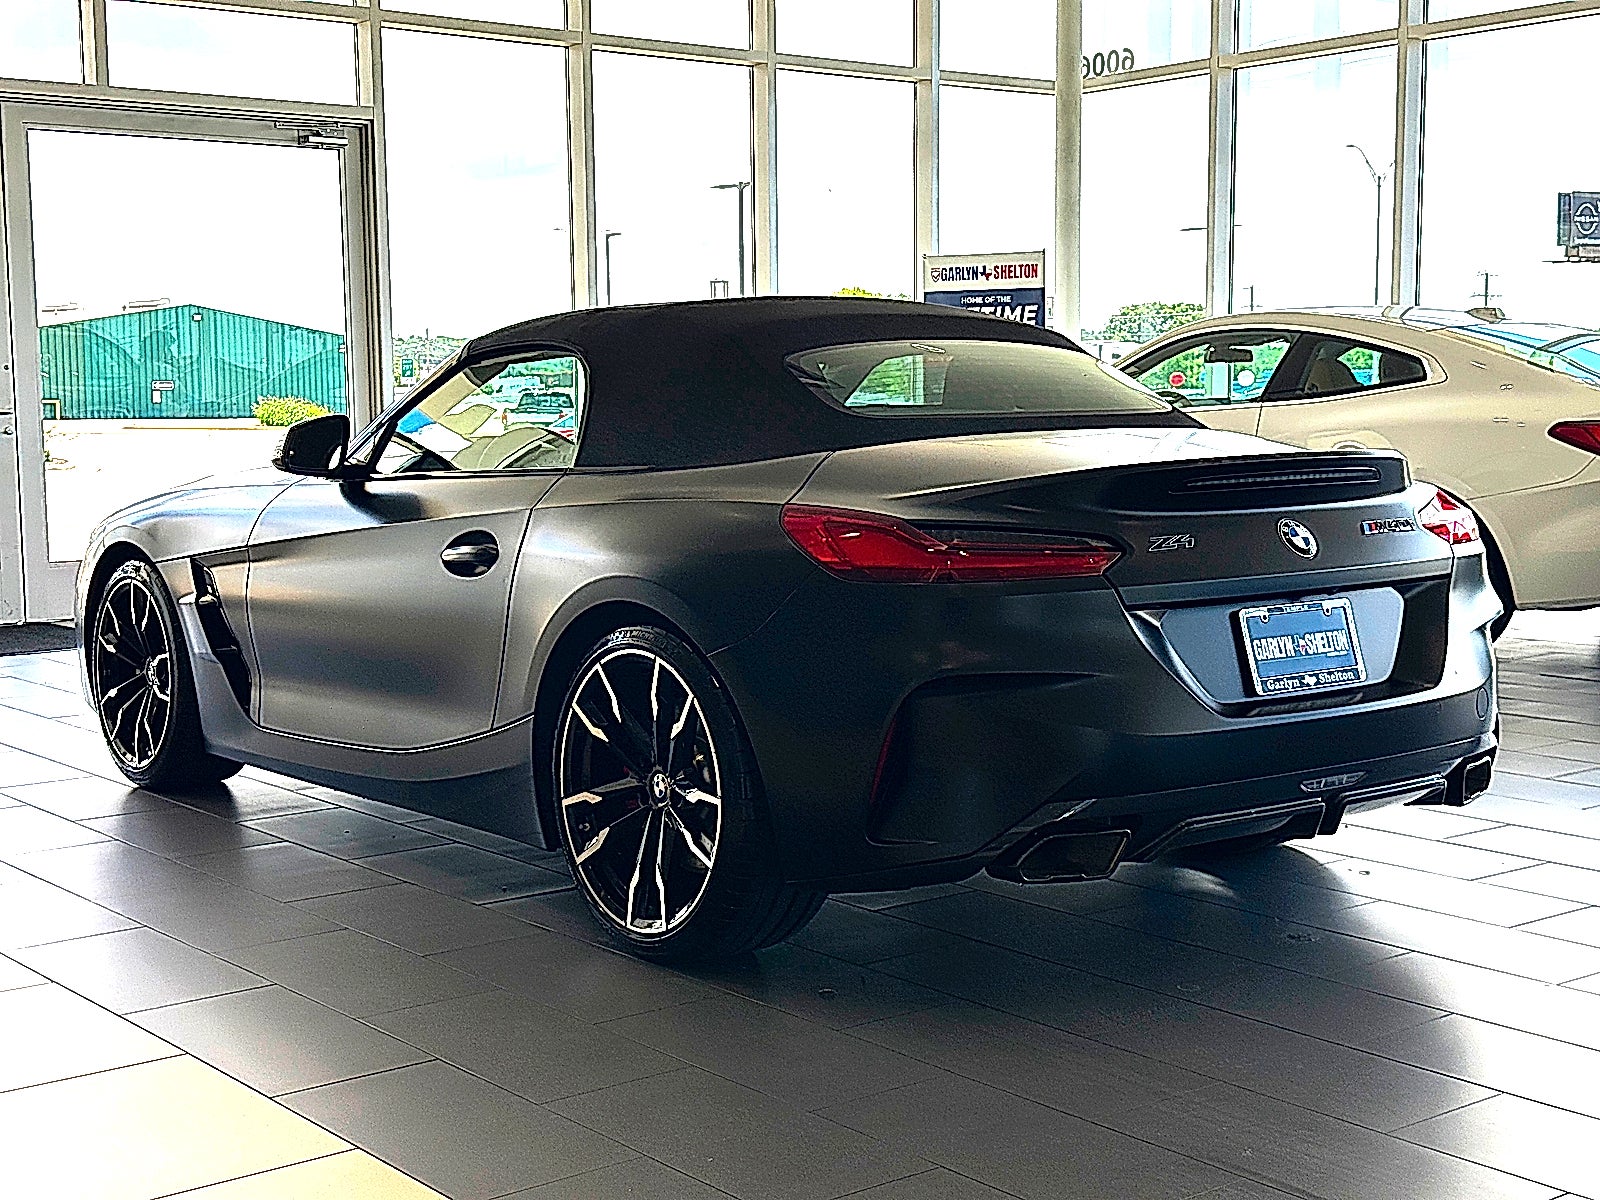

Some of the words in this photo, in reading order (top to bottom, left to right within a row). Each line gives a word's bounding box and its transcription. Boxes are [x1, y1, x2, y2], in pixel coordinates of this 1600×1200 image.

[940, 265, 979, 282] GARLYN
[993, 263, 1039, 280] SHELTON
[960, 296, 983, 304] HOME
[997, 295, 1012, 303] THE
[1148, 533, 1195, 552] Z4
[1252, 635, 1296, 661] GARLYN
[1304, 629, 1350, 654] SHELTON
[1266, 677, 1301, 691] Garlyn
[1318, 670, 1355, 684] Shelton
